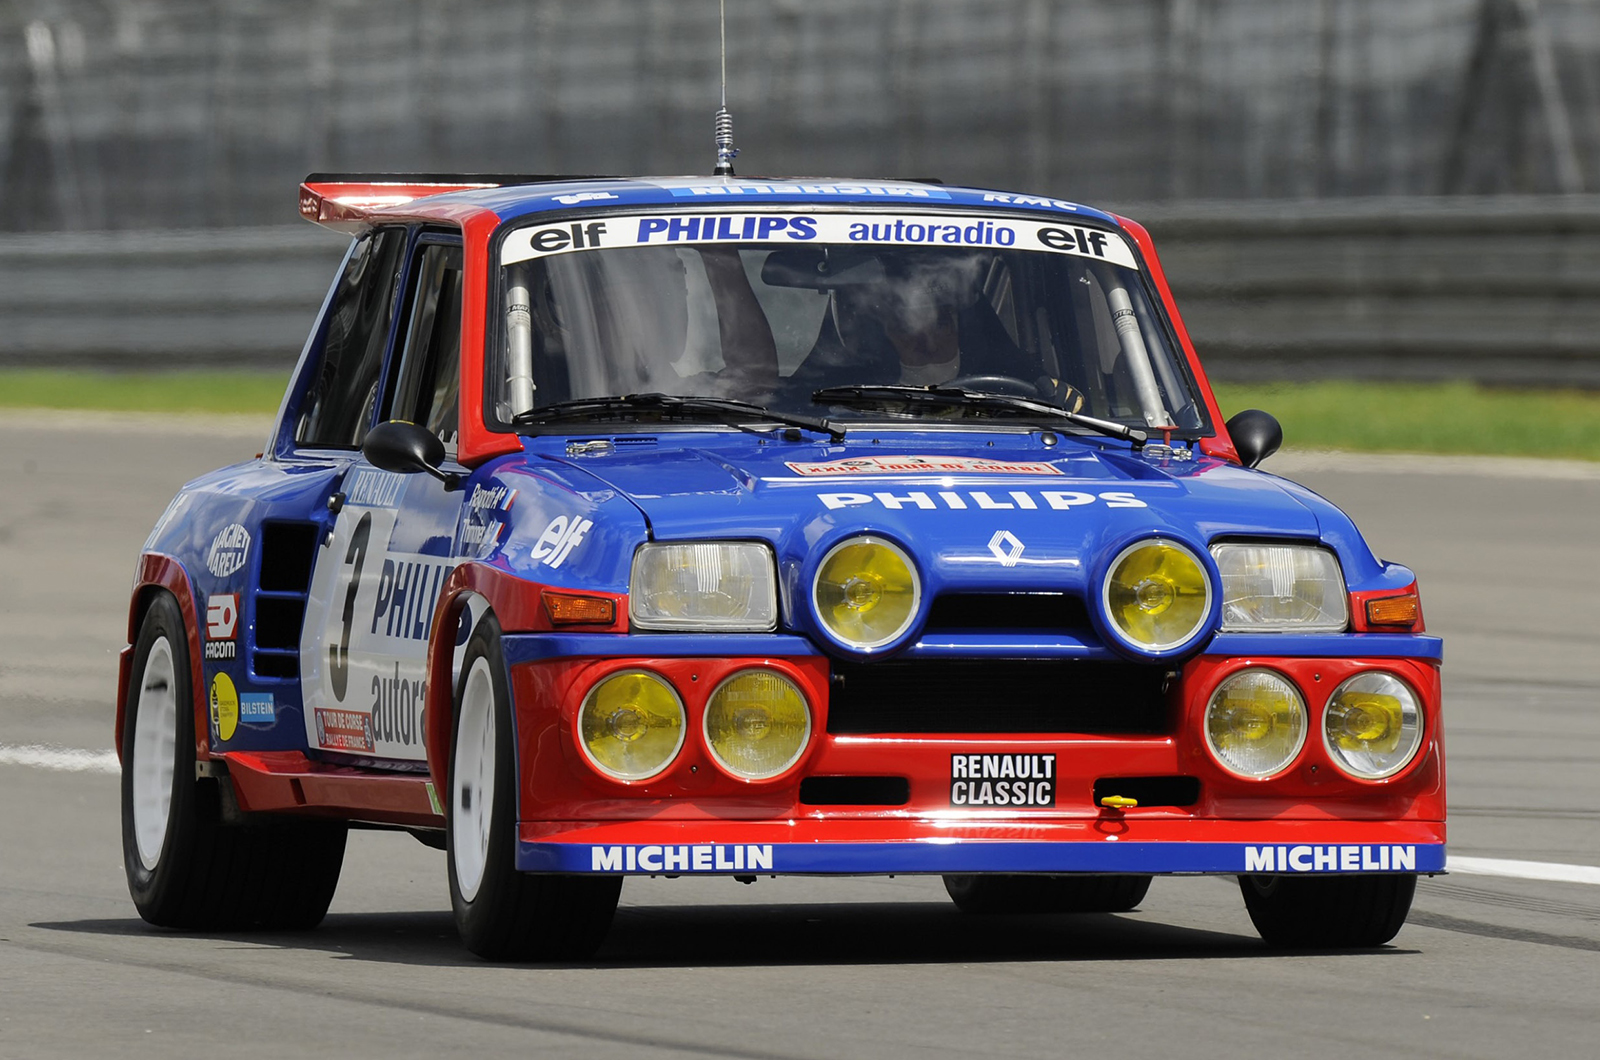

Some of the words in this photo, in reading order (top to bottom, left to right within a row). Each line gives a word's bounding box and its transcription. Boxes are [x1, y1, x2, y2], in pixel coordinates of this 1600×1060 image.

[690, 185, 930, 197] MICHELIN
[983, 193, 1077, 211] RMC
[530, 222, 607, 252] elf
[637, 216, 817, 243] PHILIPS
[848, 219, 1016, 246] autoradio
[1036, 227, 1108, 258] elf
[348, 471, 406, 506] RENAULT
[816, 491, 1148, 510] PHILIPS
[530, 514, 594, 569] elf
[329, 511, 372, 703] 3
[205, 641, 236, 659] FACOM
[241, 702, 275, 715] BILSTEIN
[323, 711, 338, 728] TOUR
[338, 712, 345, 729] DE
[345, 713, 363, 731] CORSE
[952, 755, 1055, 779] RENAULT
[952, 781, 1051, 805] CLASSIC
[591, 845, 773, 871] MICHELIN
[1245, 845, 1416, 871] MICHELIN
